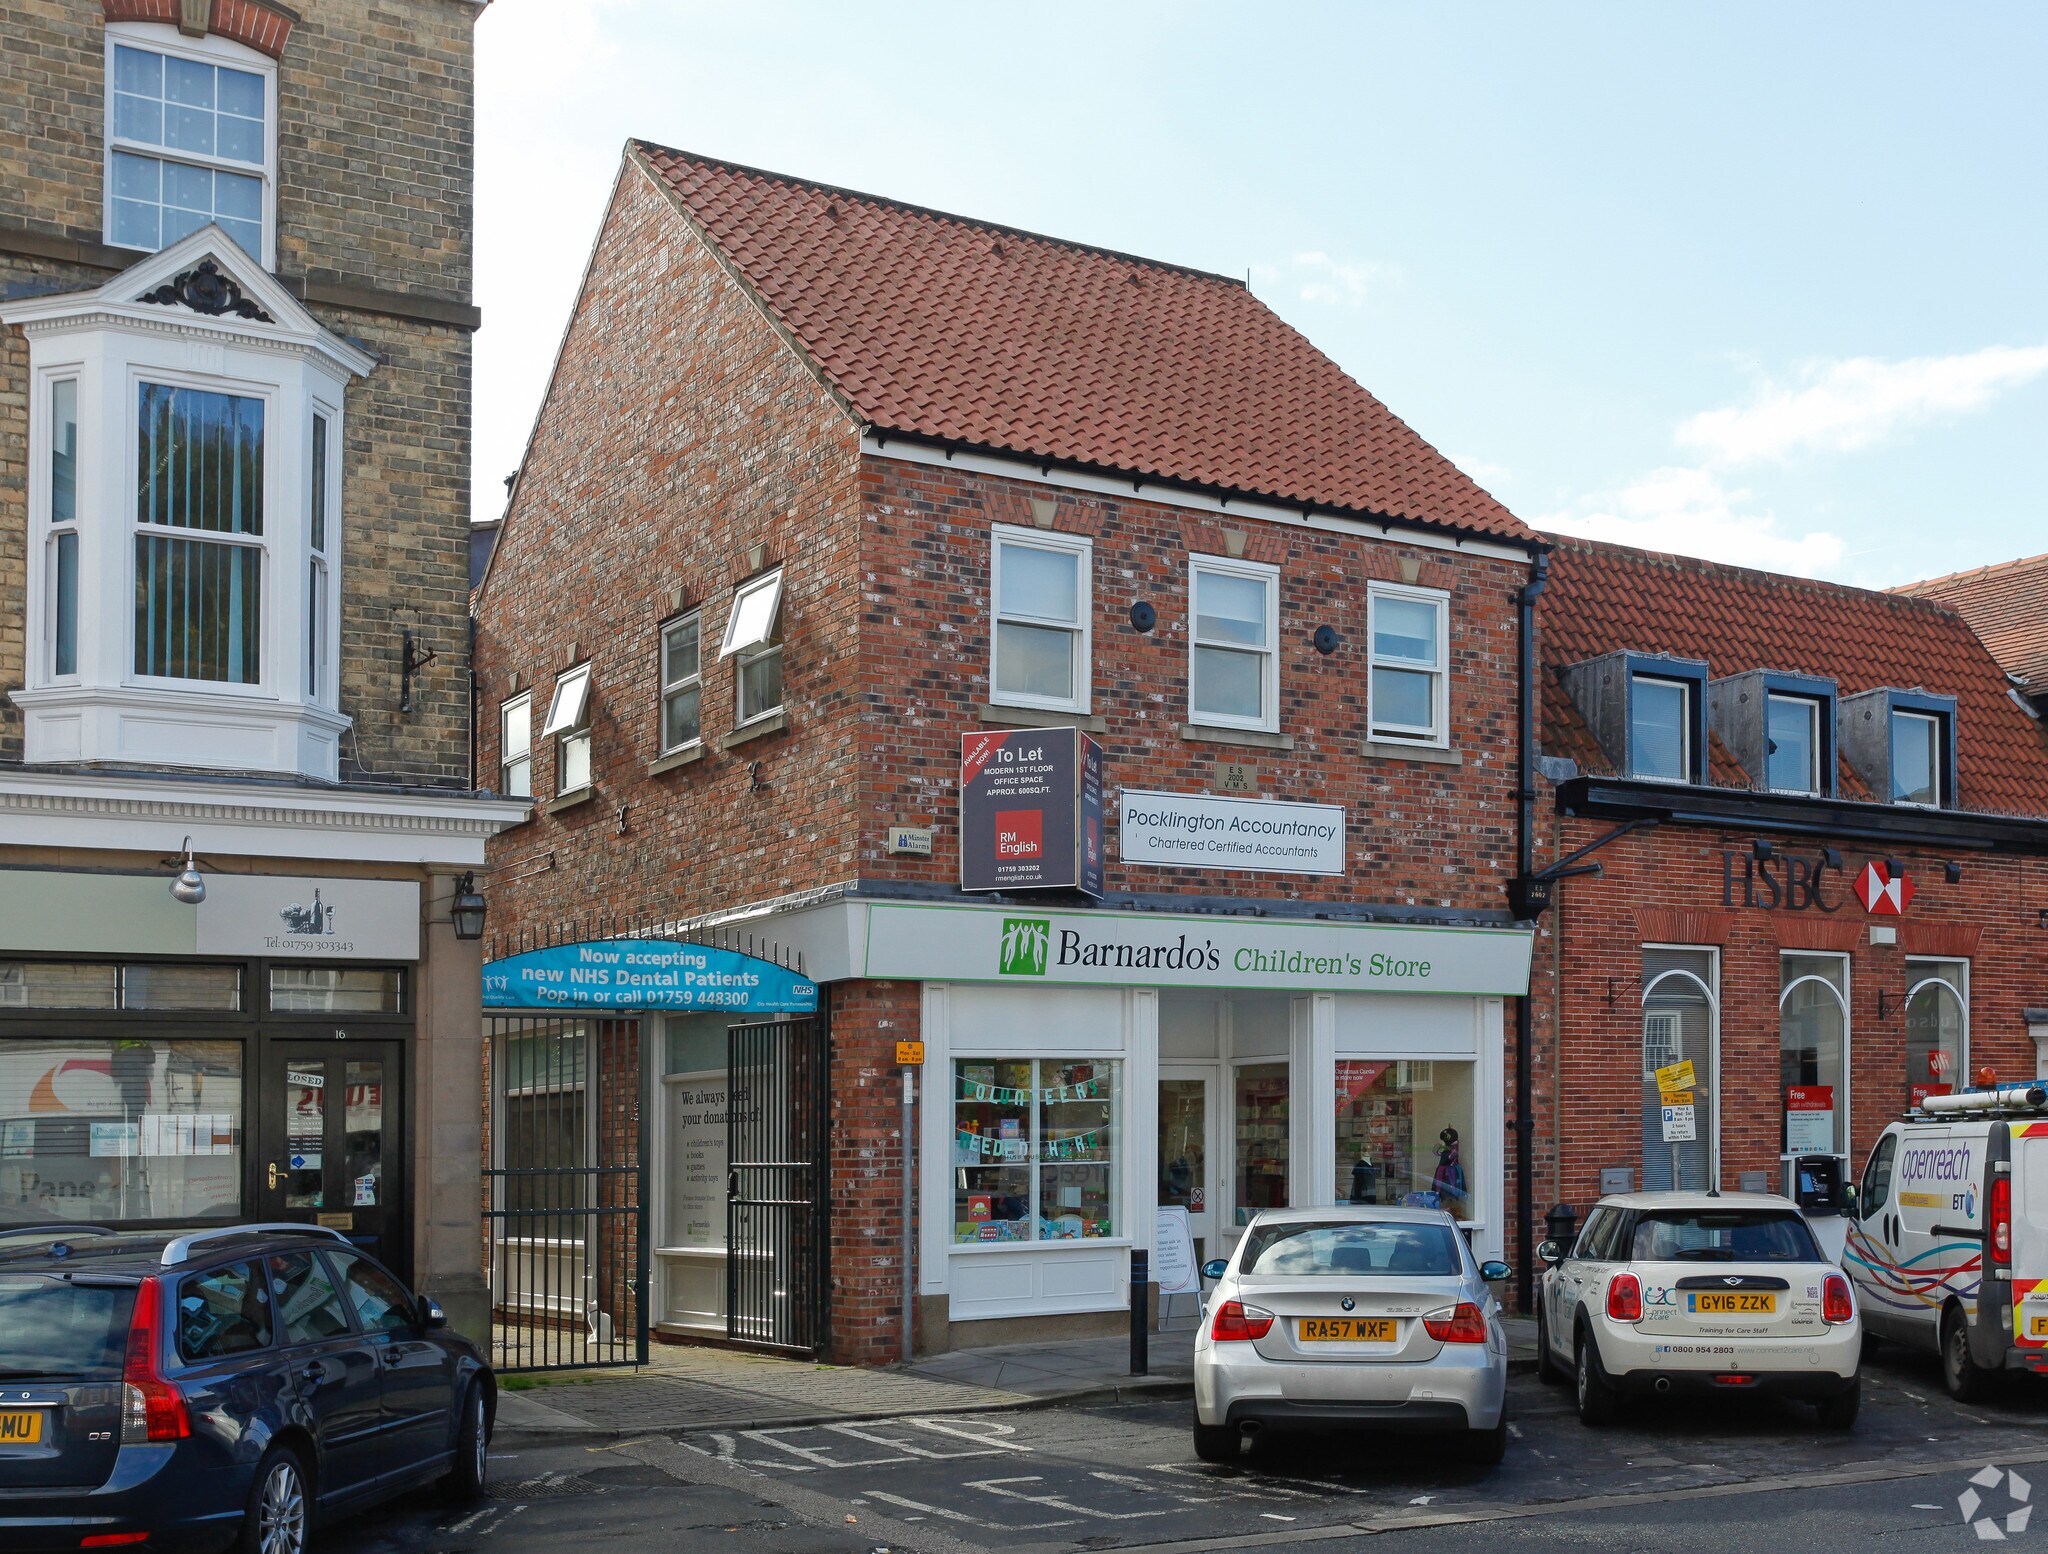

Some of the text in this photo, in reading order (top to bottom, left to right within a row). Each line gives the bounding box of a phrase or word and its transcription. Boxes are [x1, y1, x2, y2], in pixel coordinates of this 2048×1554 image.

[963, 736, 990, 767] AVAILABLE
[995, 747, 1043, 763] To Let
[975, 749, 991, 766] NOW!
[984, 765, 1054, 775] MODERN 1ST FLOOR
[1229, 766, 1243, 775] E S
[994, 776, 1044, 786] OFFICE SPACE
[1227, 774, 1244, 782] 2002
[1233, 781, 1239, 789] M
[1243, 782, 1248, 790] S
[986, 788, 1017, 796] APPROX.
[1127, 808, 1337, 842] Pocklington Accountancy
[907, 834, 930, 842] Minster
[1000, 832, 1017, 842] RM
[907, 842, 930, 850] Alarms
[1000, 841, 1038, 856] English
[1148, 836, 1318, 858] Chartered Certified Accountants
[995, 874, 1043, 882] rmenglish.co.uk
[1720, 850, 1844, 913] HSBC
[263, 936, 354, 952] Tel: 01759 303343
[579, 948, 707, 969] Now accepting
[1056, 929, 1432, 978] Barnardo's Children's Store
[522, 967, 760, 987] new NHS Dental Patients
[793, 986, 813, 994] NHS
[537, 986, 749, 1006] Pop in or call 01759 448300
[335, 1029, 346, 1039] 16
[288, 1073, 322, 1085] LOSED
[1790, 1089, 1806, 1100] Free
[1913, 1087, 1928, 1098] Free
[682, 1092, 694, 1105] We
[695, 1090, 725, 1107] always
[1665, 1110, 1672, 1121] P
[682, 1114, 702, 1129] your
[690, 1139, 724, 1148] children's toys
[1048, 1131, 1099, 1157] HERE
[690, 1151, 704, 1159] books
[690, 1164, 705, 1172] games
[1902, 1141, 1971, 1187] openreach
[690, 1174, 719, 1183] activity toys
[1952, 1194, 1965, 1211] BT
[1701, 1295, 1770, 1310] GY16 ZZK
[1645, 1308, 1677, 1317] Connect
[1648, 1312, 1670, 1321] 2care
[1306, 1321, 1389, 1337] RA57 WXF
